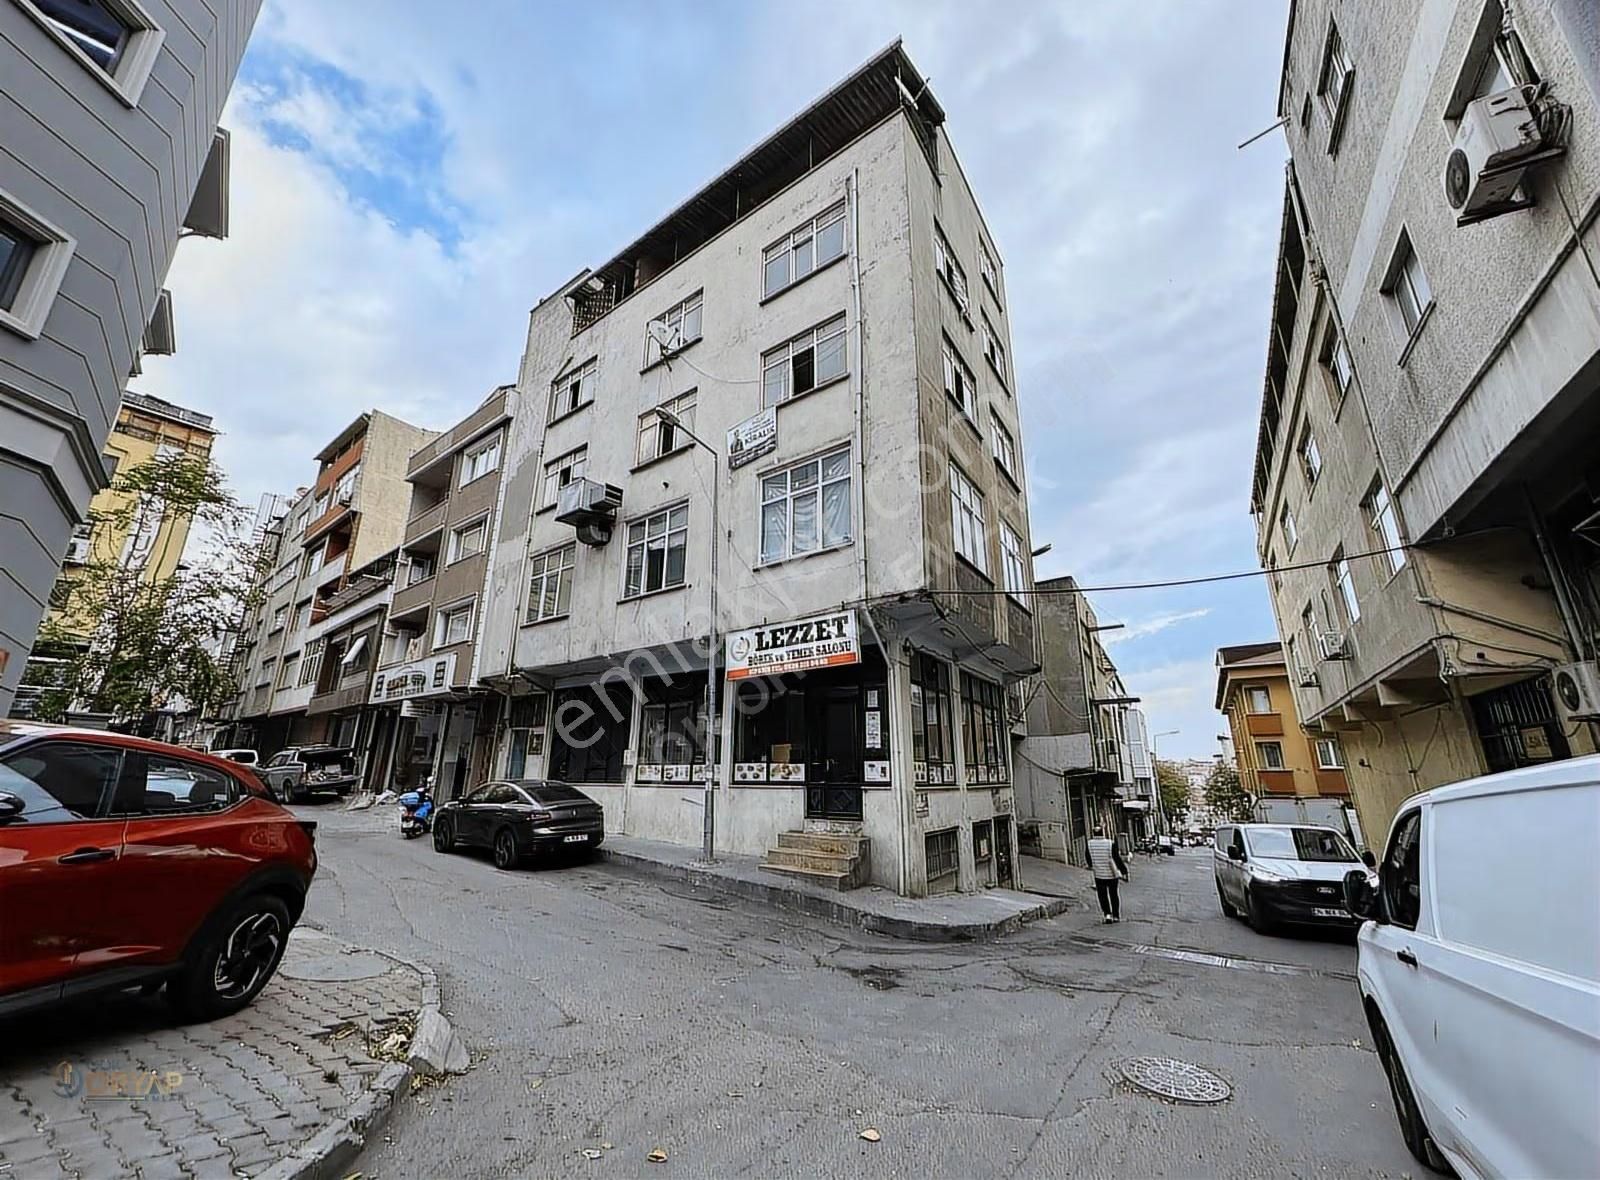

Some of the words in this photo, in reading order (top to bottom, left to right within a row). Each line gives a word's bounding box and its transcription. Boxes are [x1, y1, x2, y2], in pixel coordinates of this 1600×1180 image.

[755, 615, 849, 651] LEZZET
[785, 646, 814, 661] YEMEK
[815, 640, 852, 656] SALONU
